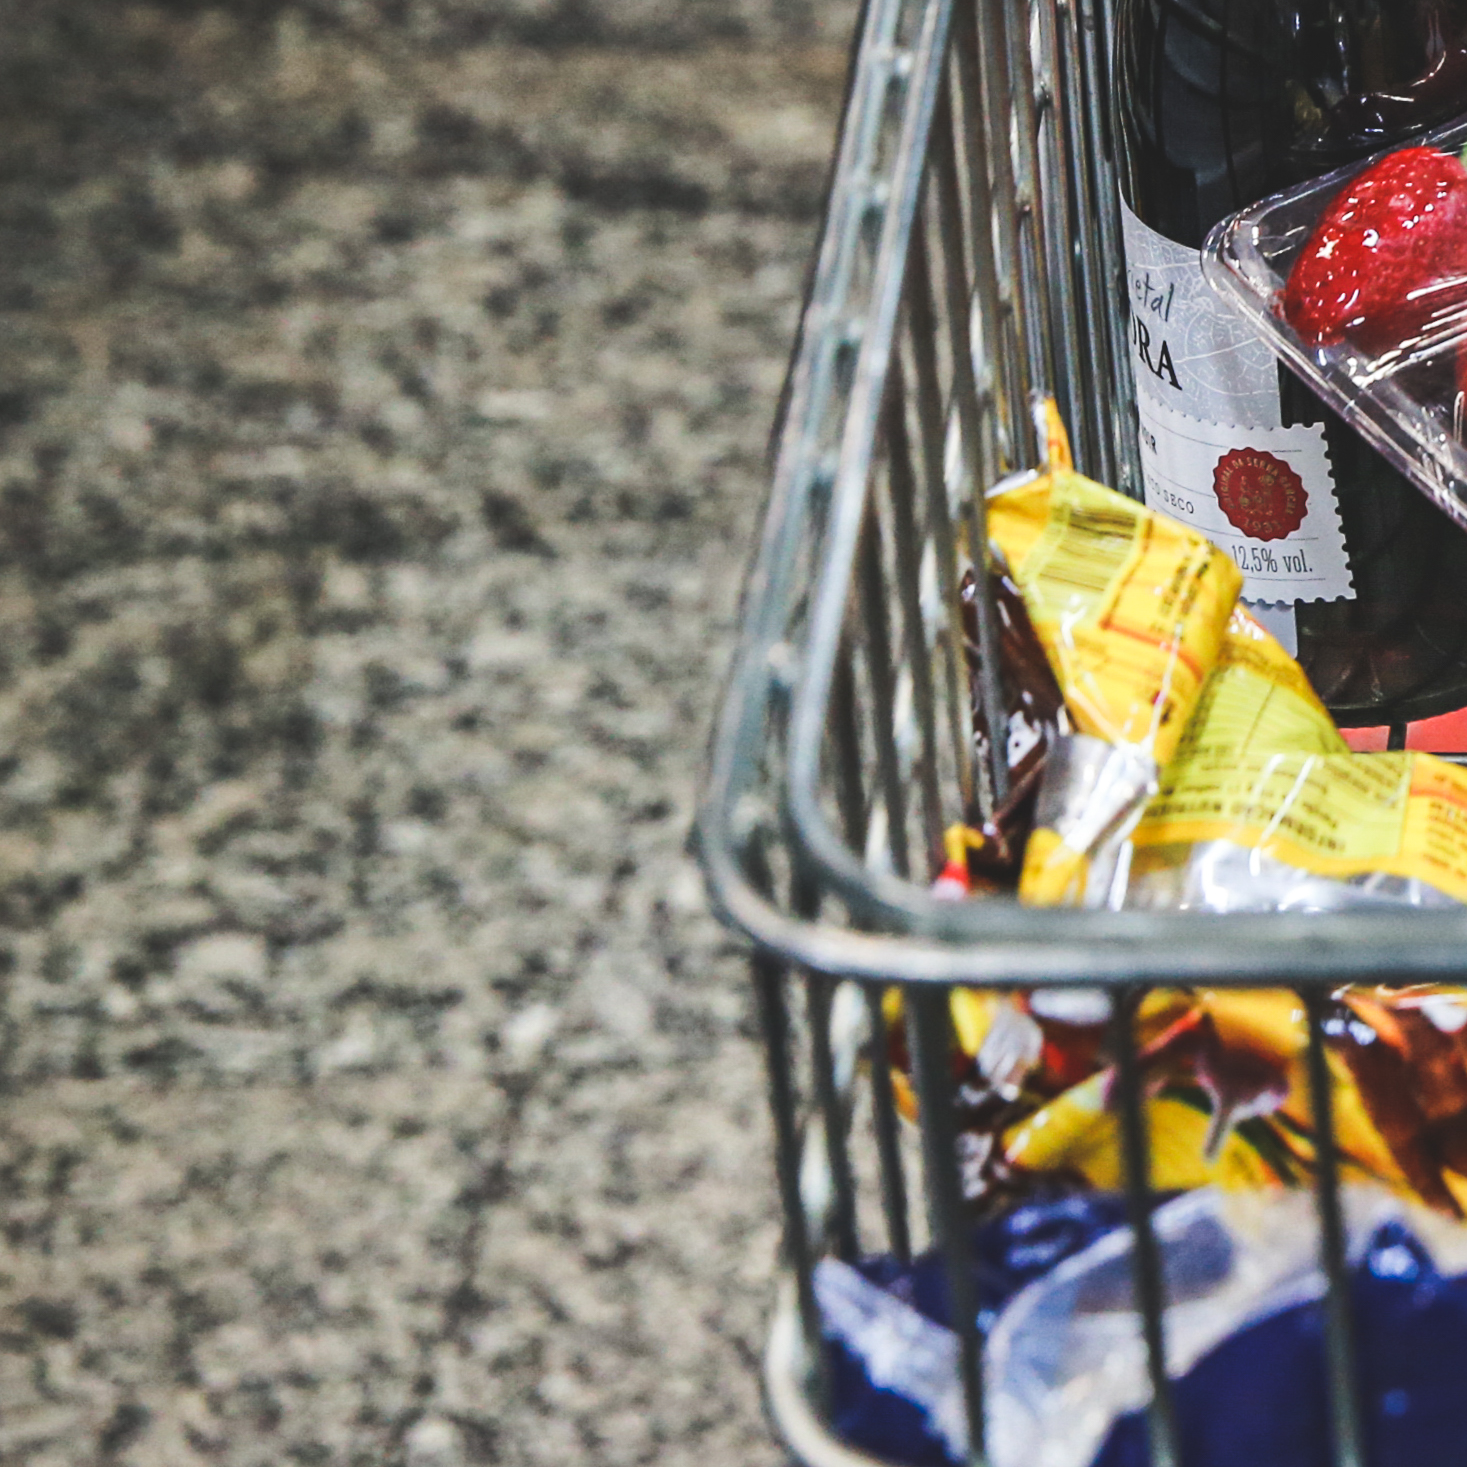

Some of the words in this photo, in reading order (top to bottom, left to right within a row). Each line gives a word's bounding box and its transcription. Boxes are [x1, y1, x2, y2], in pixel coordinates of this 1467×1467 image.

[1162, 489, 1195, 515] SECO
[1231, 544, 1278, 573] 12,5%
[1282, 548, 1313, 573] vol.
